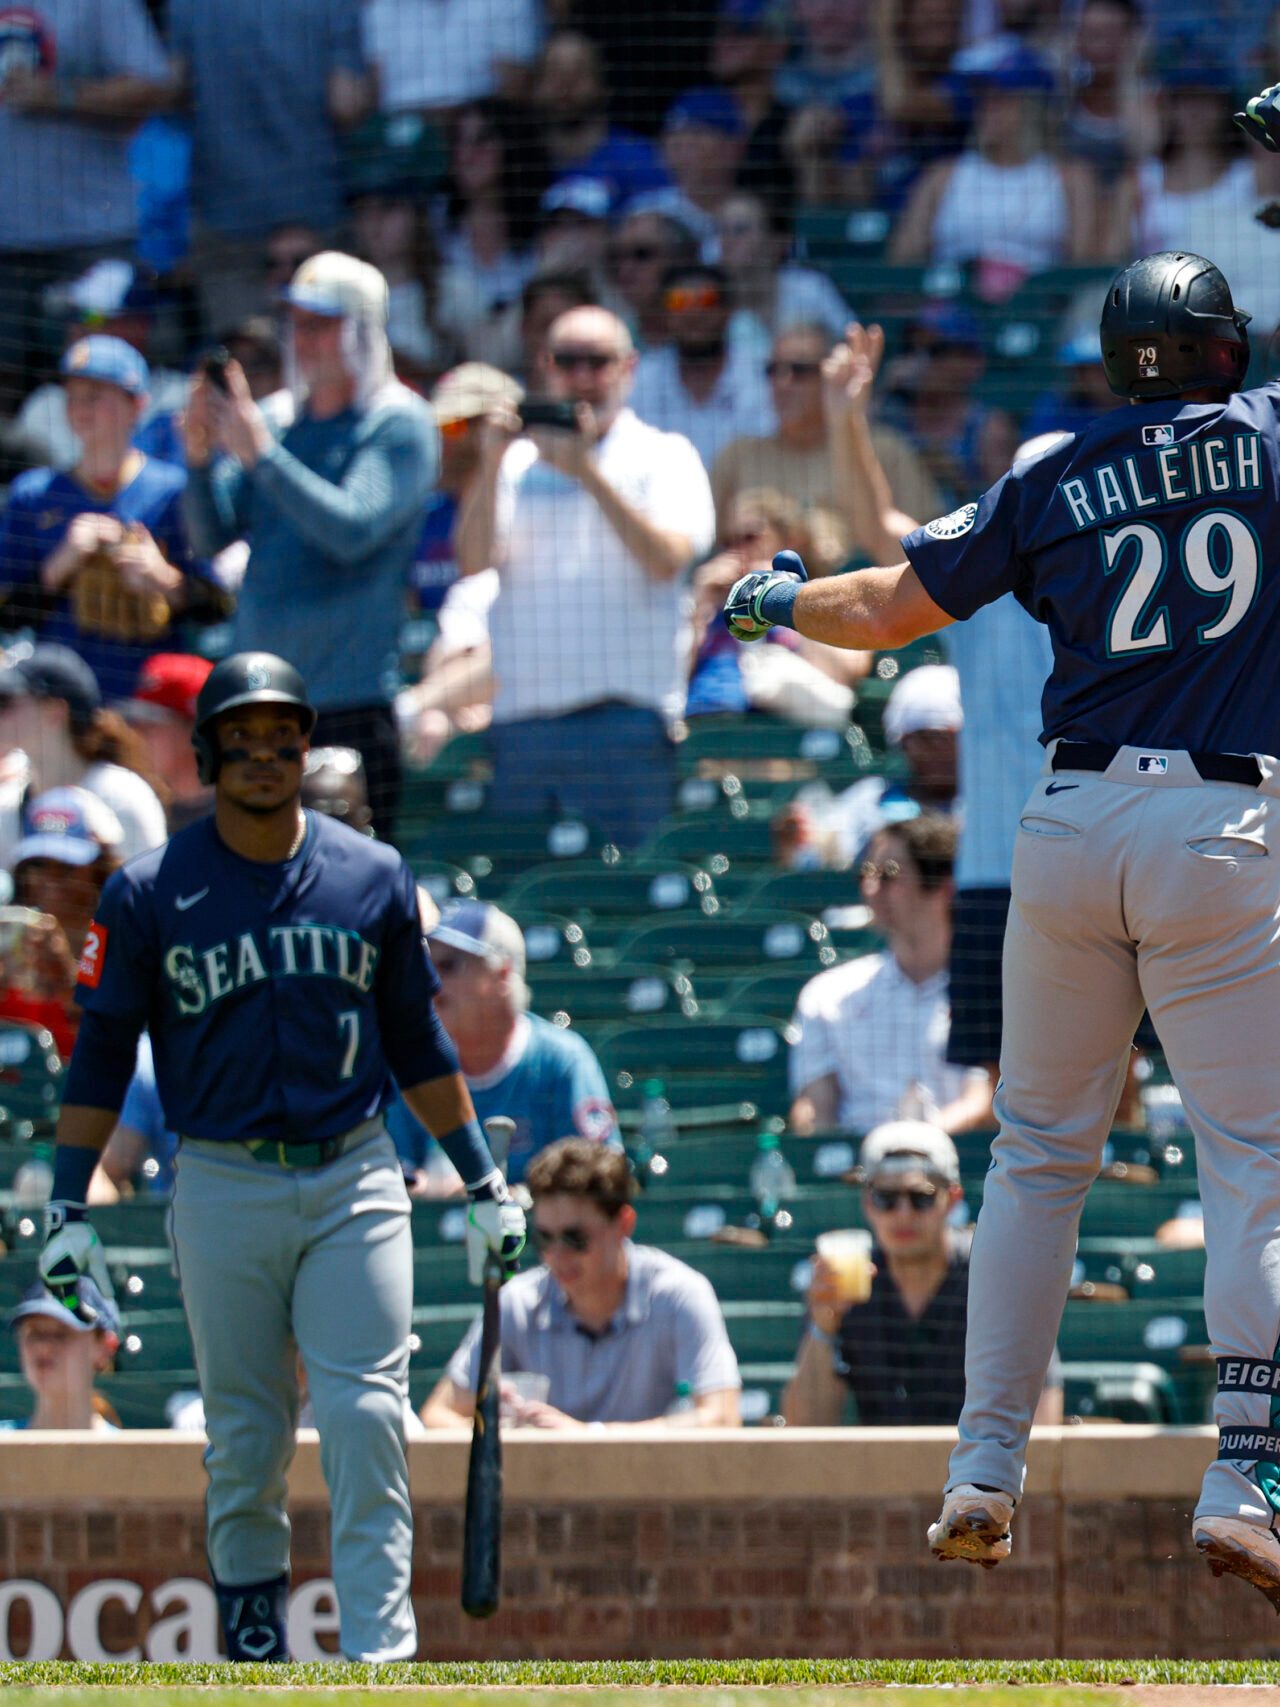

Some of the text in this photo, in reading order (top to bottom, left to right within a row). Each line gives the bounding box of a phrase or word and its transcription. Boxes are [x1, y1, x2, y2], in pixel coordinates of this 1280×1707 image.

[1137, 347, 1158, 366] 29
[1057, 433, 1263, 531] RALEIGH
[1101, 508, 1263, 659] 29
[83, 931, 100, 960] 2
[164, 923, 379, 1015] SEATTLE
[337, 1010, 360, 1080] 7
[0, 1577, 342, 1662] ocae
